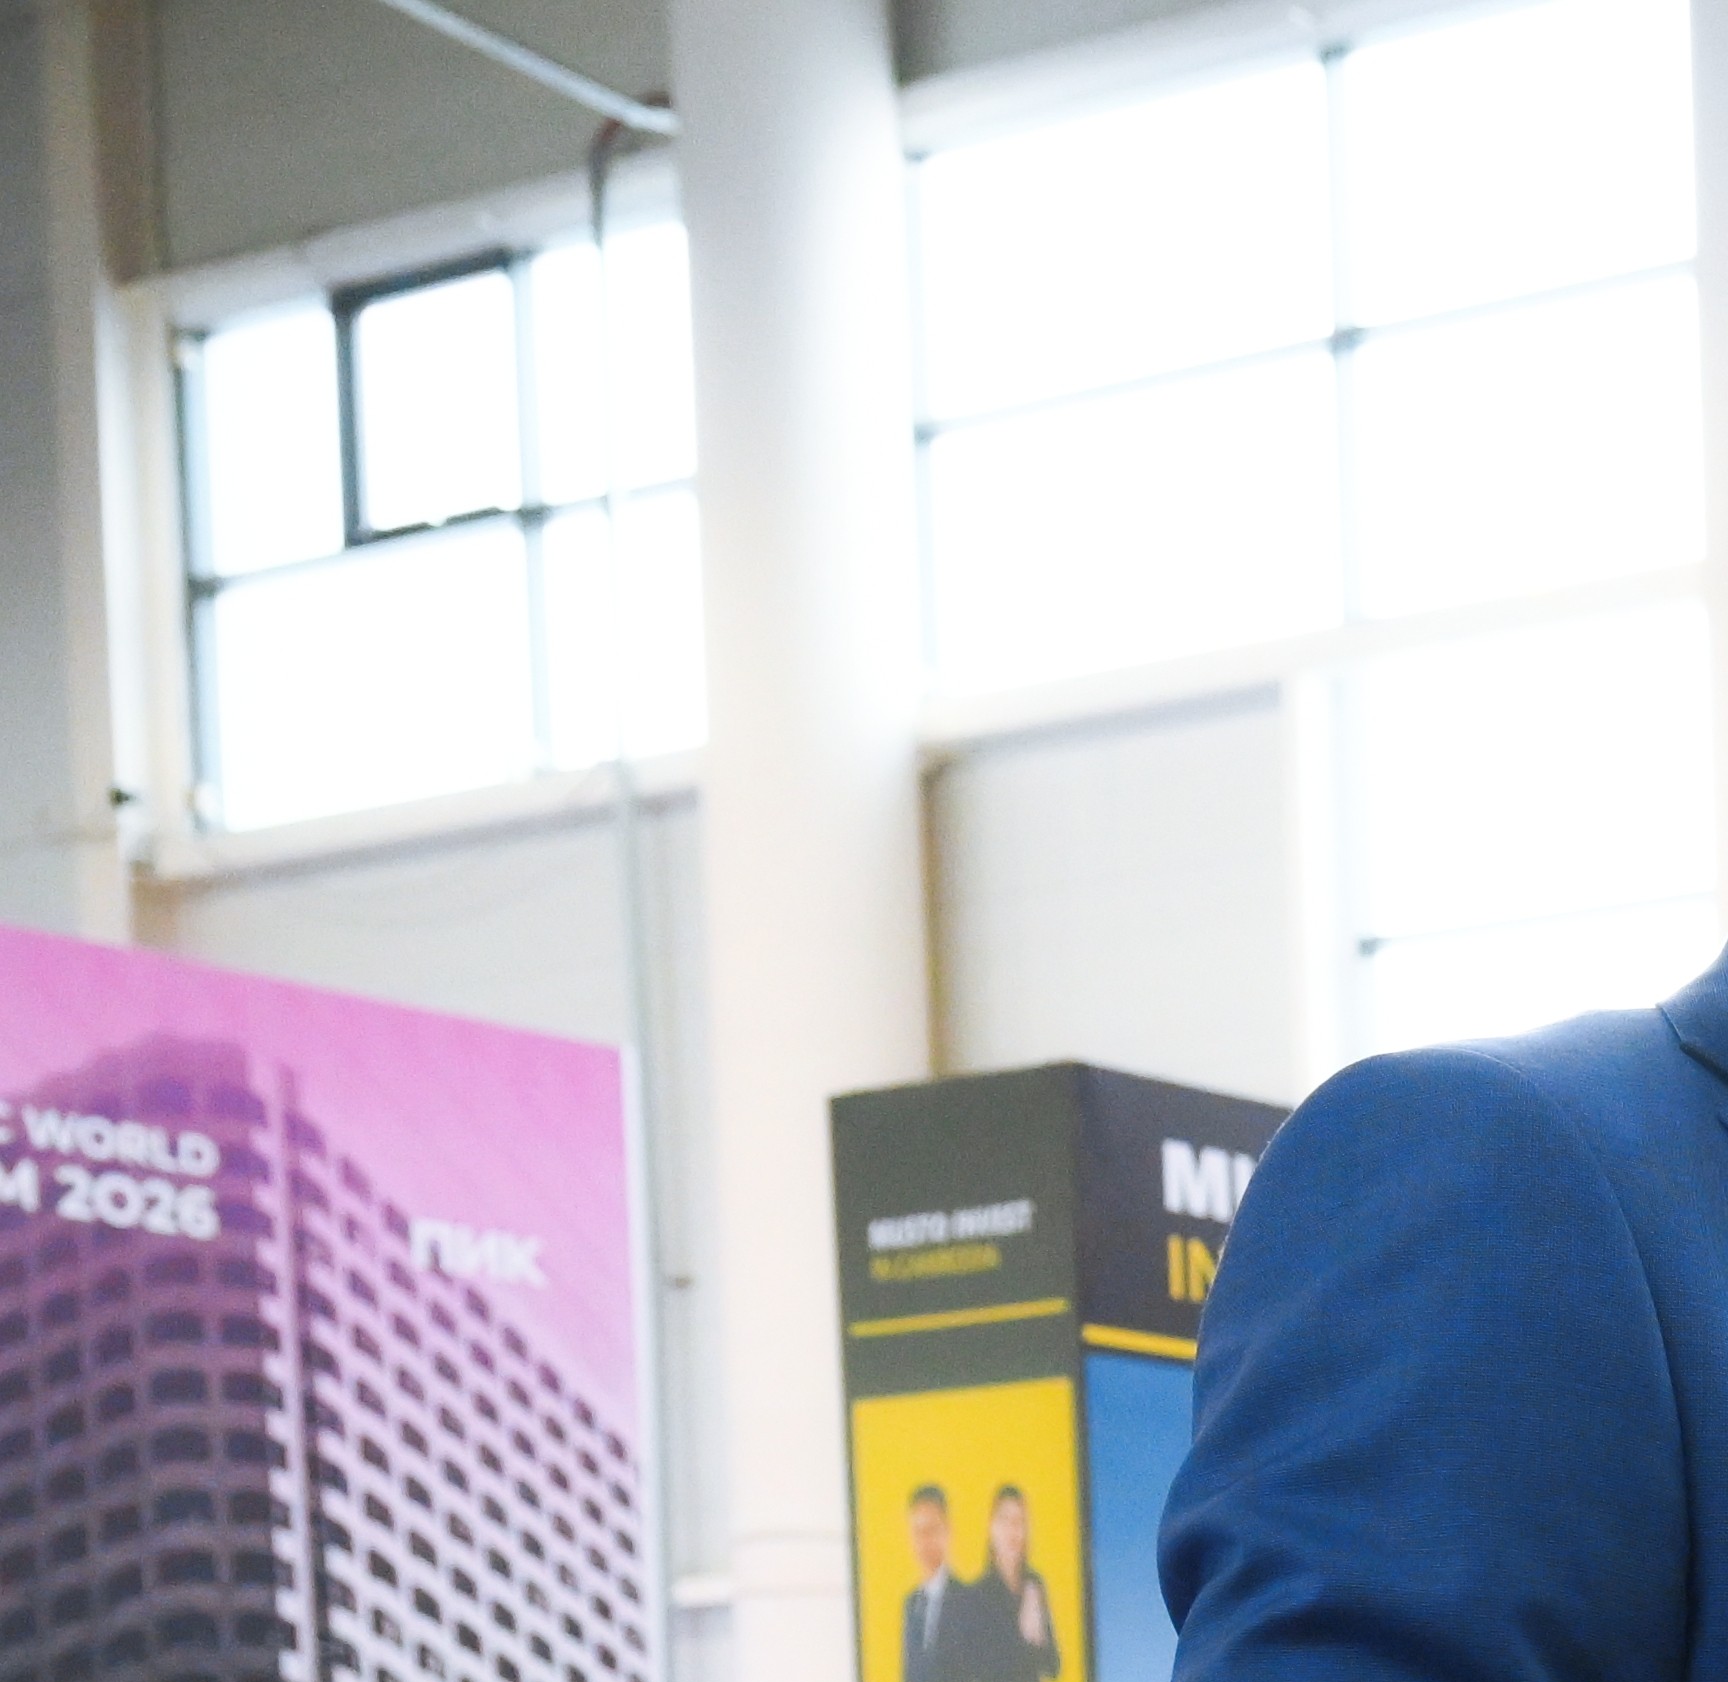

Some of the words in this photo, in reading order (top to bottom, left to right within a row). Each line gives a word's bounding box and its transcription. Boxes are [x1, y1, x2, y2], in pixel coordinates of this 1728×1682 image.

[22, 1105, 220, 1178] WORLD
[54, 1163, 220, 1241] 2026
[409, 1218, 545, 1286] ПИК
